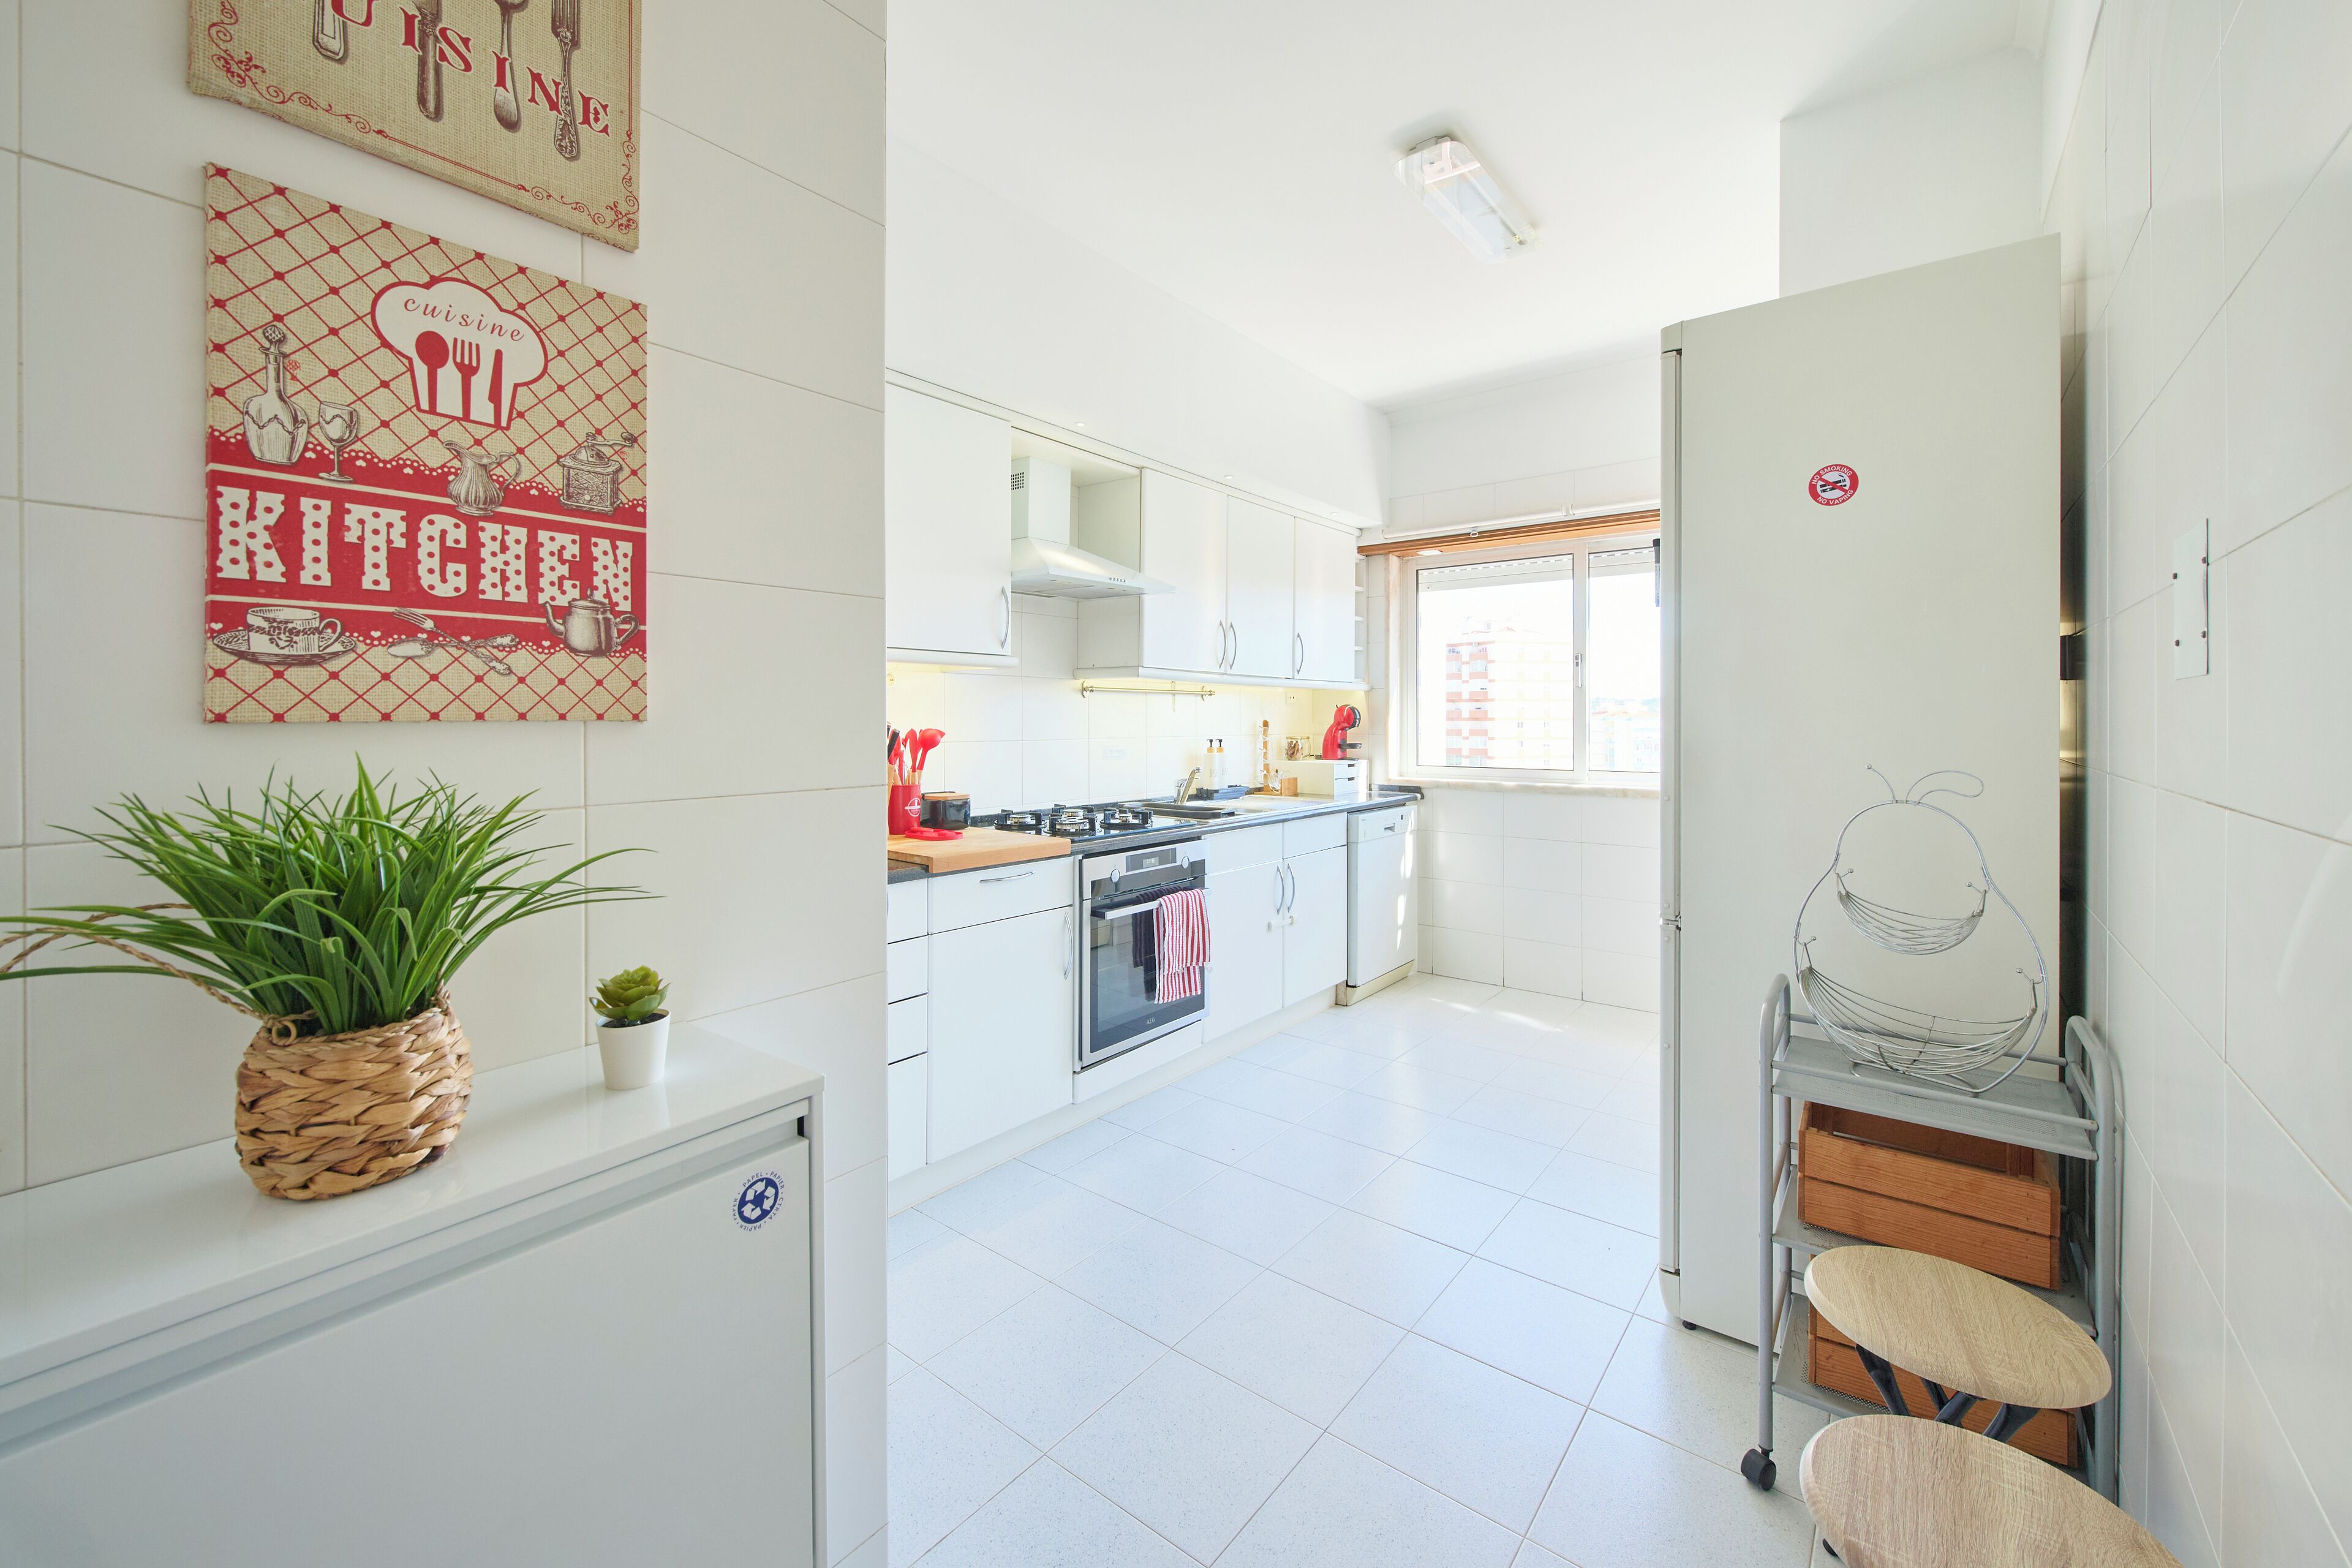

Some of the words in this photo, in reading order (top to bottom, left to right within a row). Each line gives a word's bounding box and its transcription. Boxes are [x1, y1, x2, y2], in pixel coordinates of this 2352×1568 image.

[404, 298, 525, 342] cuisine
[1811, 475, 1820, 484] NO
[1819, 466, 1852, 477] SMOKING
[1829, 489, 1853, 505] VAPING
[216, 485, 634, 611] KITCHEN
[742, 1172, 763, 1188] PAPEL
[769, 1171, 785, 1189] PAPIER
